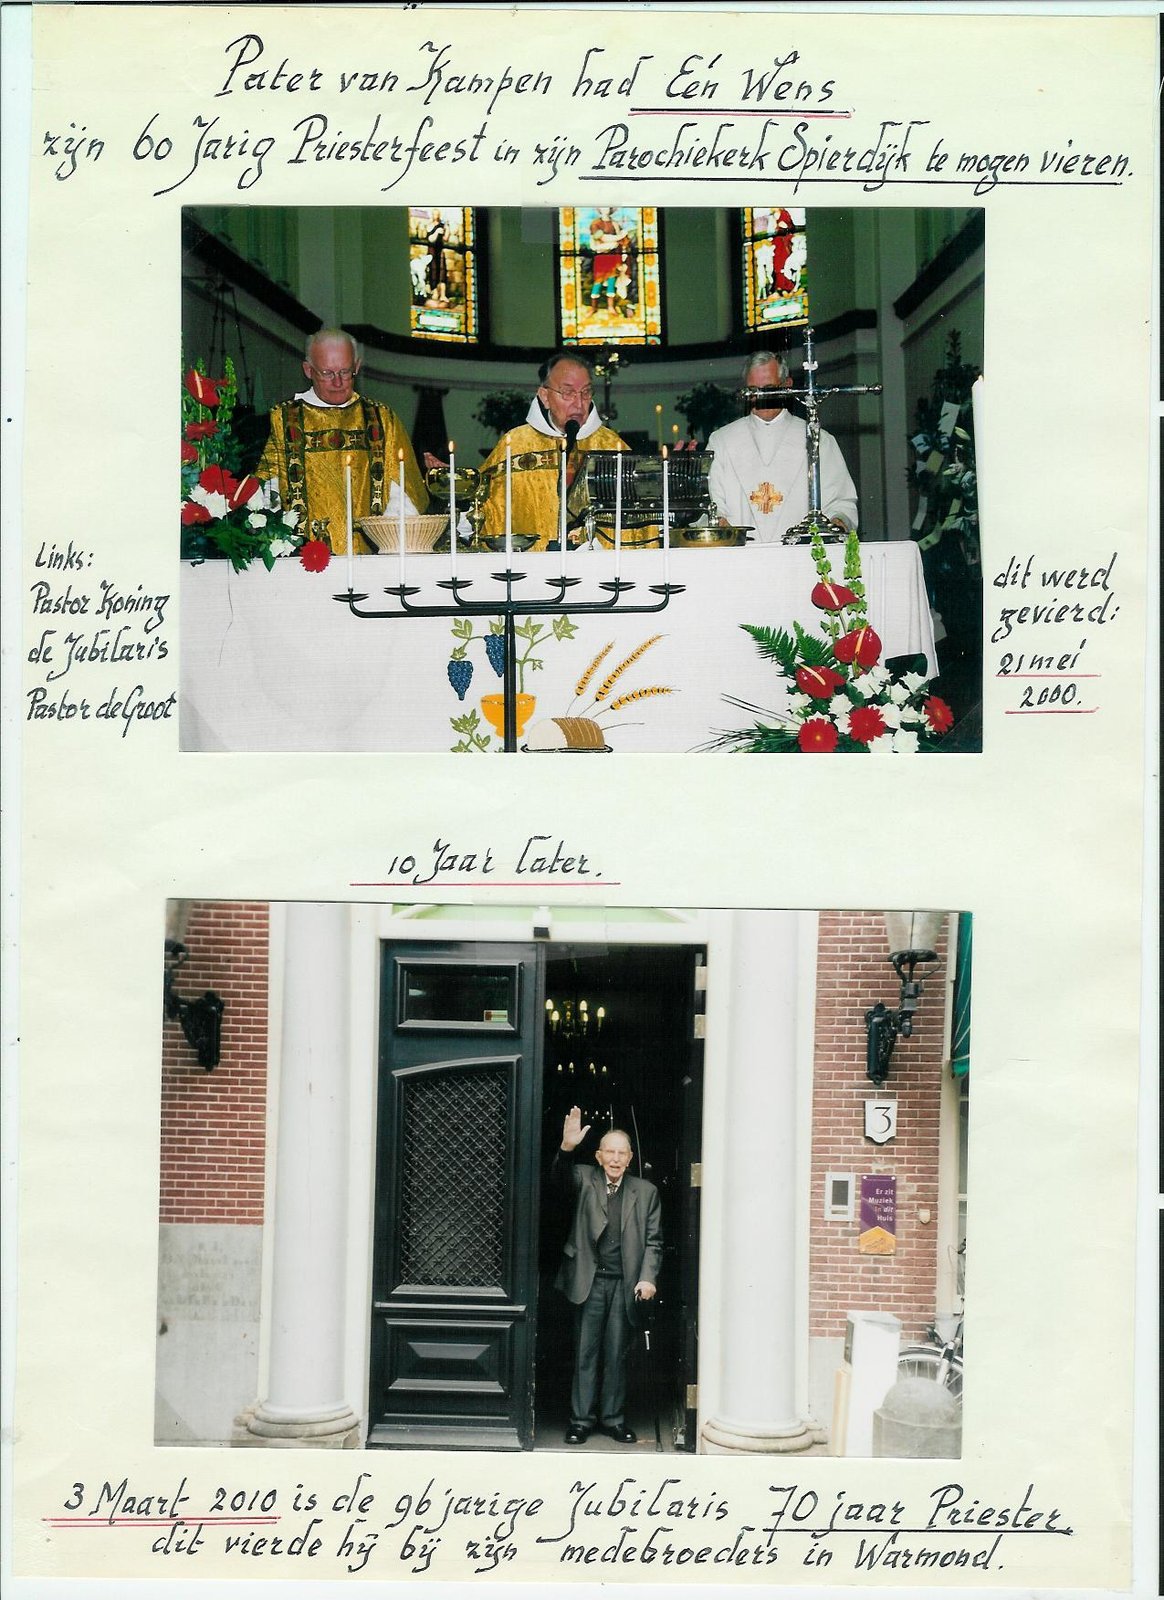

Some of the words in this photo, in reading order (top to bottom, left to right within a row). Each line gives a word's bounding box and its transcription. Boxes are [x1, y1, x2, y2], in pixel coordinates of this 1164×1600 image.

[215, 34, 322, 98] Pater
[339, 72, 399, 93] van
[406, 41, 551, 115] Kampen
[572, 47, 655, 98] had
[742, 50, 836, 102] Wens
[133, 113, 174, 162] 60
[153, 115, 275, 196] Jarig
[287, 113, 486, 191] Priesterfeest
[493, 133, 521, 164] in
[592, 119, 773, 171] Parochiekerk
[925, 139, 950, 172] te
[1040, 138, 1134, 178] vieren.
[955, 152, 1030, 196] mogen
[35, 540, 94, 571] Links:
[993, 554, 1035, 589] dit
[1041, 551, 1118, 591] werd
[30, 580, 91, 615] Pastor
[95, 579, 171, 634] Koning
[991, 592, 1120, 643] gevierd:
[28, 630, 57, 663] de
[46, 626, 169, 682] Jubilaris
[27, 687, 91, 721] Pastor
[1020, 683, 1082, 708] 2000.
[388, 855, 416, 875] 10
[412, 838, 495, 885] Jaar
[872, 1106, 892, 1134] 3
[64, 1482, 85, 1510] 3
[89, 1477, 189, 1525] Maart
[209, 1487, 277, 1512] 2010
[292, 1484, 318, 1512] is
[332, 1473, 375, 1513] de
[424, 1488, 544, 1541] jarige
[535, 1478, 729, 1543] Jubilaris
[768, 1484, 818, 1550] 70
[812, 1490, 906, 1540] jaar
[151, 1520, 205, 1556] dit
[225, 1519, 323, 1557] vierde
[560, 1525, 780, 1566] medebroeders
[802, 1539, 833, 1567] in
[854, 1529, 1005, 1571] Warmond.
